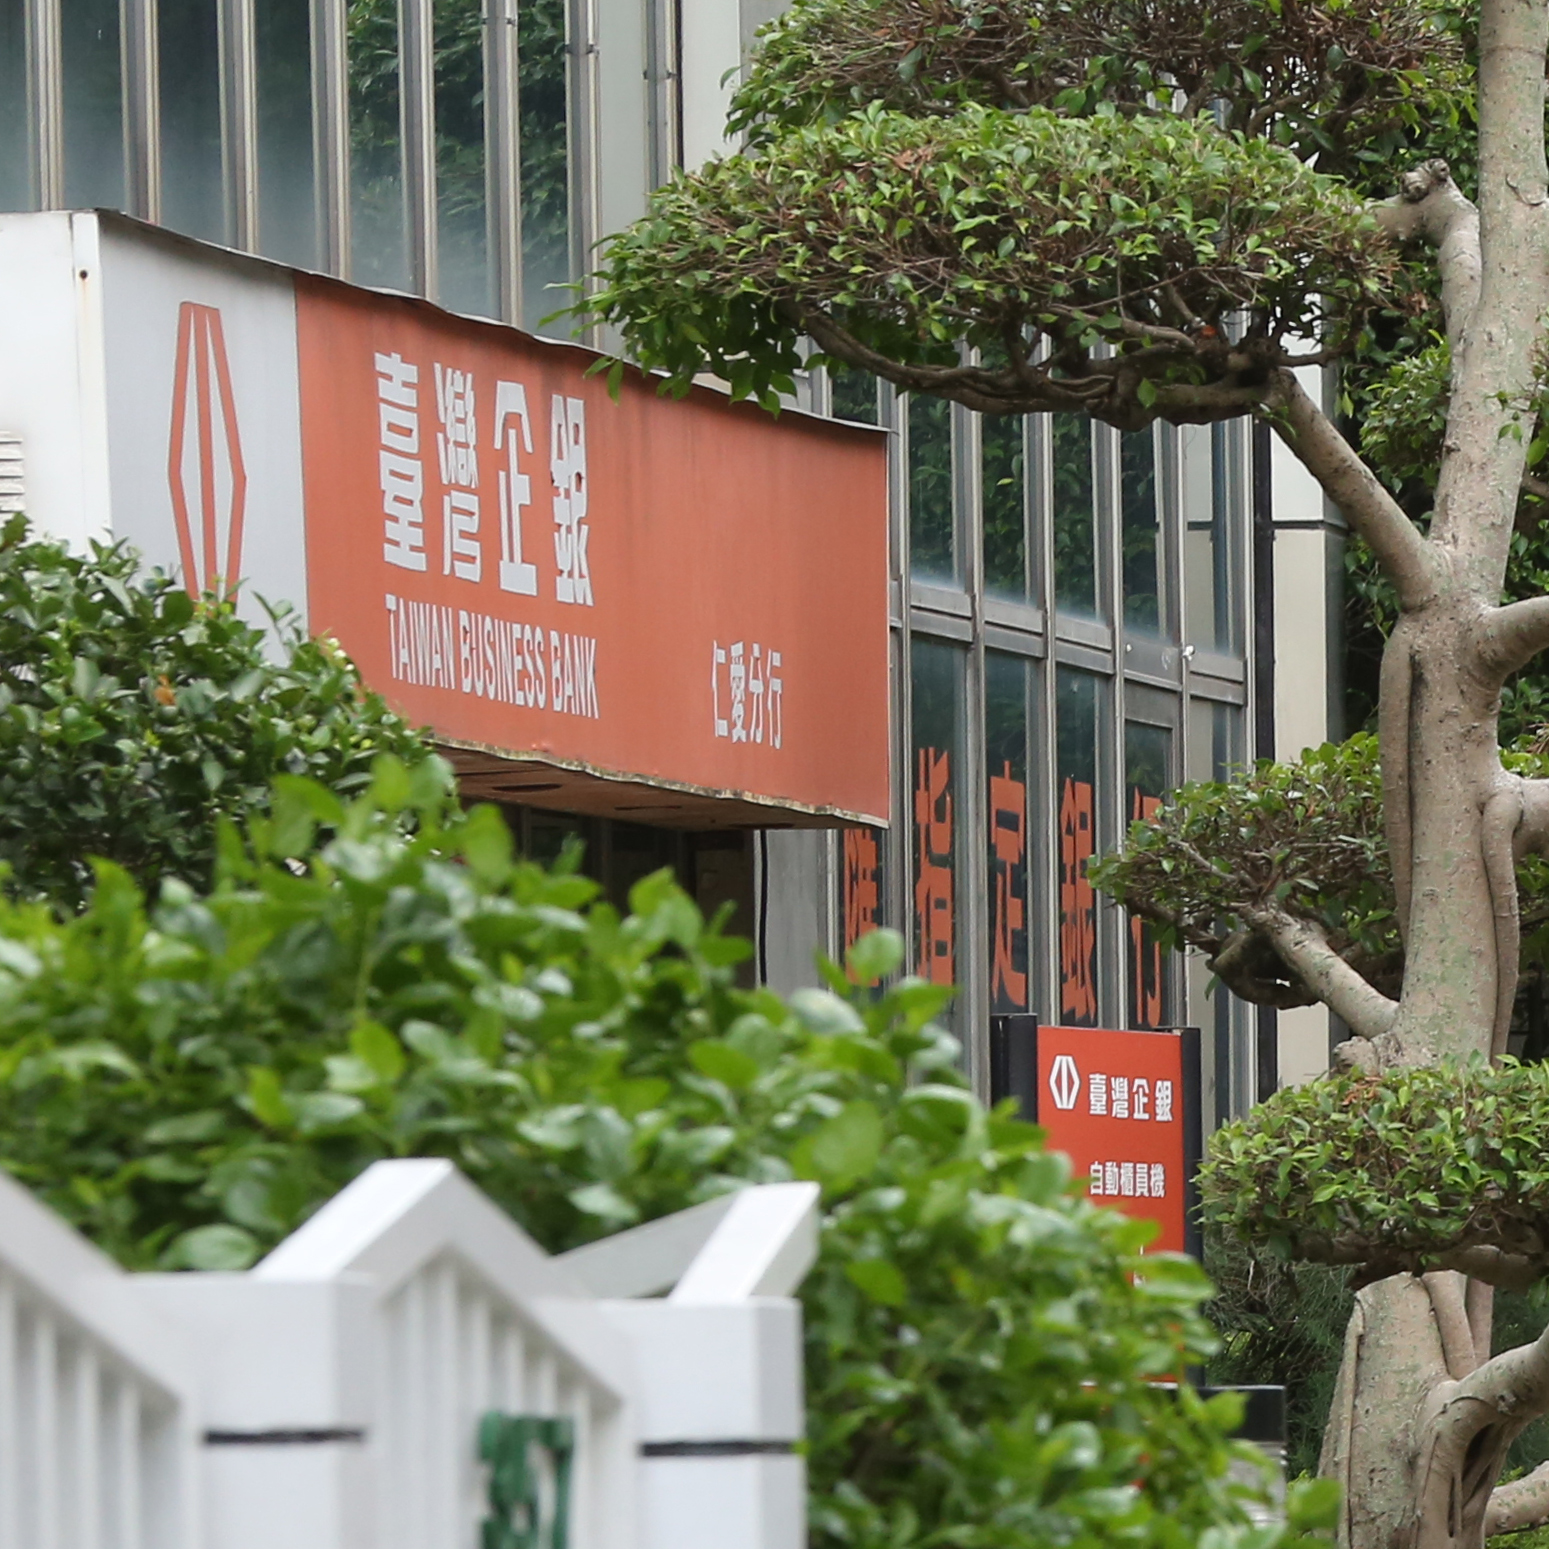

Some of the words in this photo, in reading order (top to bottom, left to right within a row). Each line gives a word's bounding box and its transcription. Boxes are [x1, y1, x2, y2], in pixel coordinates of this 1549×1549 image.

[374, 351, 595, 607] 臺灣企銀
[385, 593, 457, 690] TAIWAN
[459, 609, 547, 710] BUSINESS
[550, 629, 600, 719] BANK
[711, 639, 783, 750] 仁愛分行
[1088, 1072, 1173, 1123] 臺灣企銀
